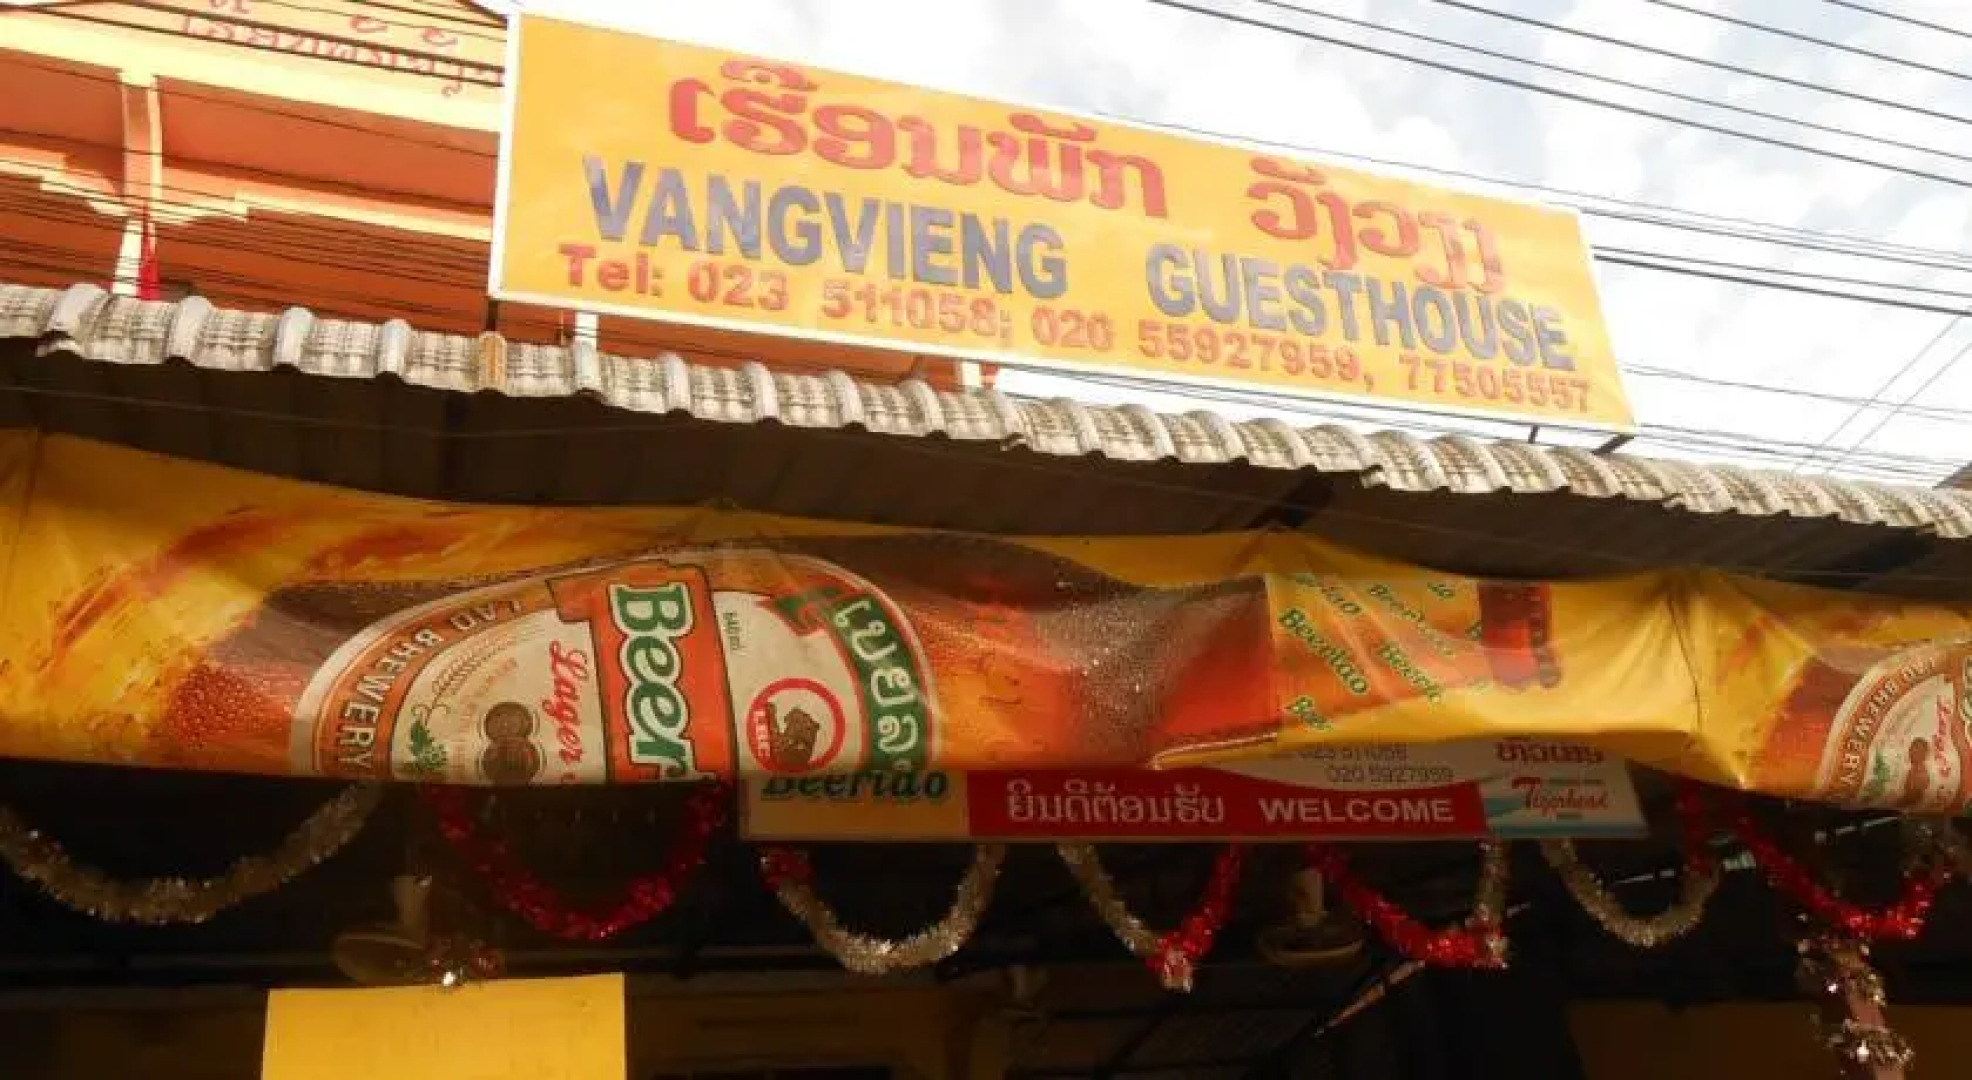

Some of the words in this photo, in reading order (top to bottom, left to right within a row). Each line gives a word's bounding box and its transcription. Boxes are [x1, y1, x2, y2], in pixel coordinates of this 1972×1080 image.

[558, 243, 663, 297] Tel:
[687, 261, 790, 312] 023
[820, 280, 1013, 343] 511058;
[1030, 308, 1114, 352] 020
[1137, 319, 1376, 391] 55927959,
[1398, 353, 1591, 413] 77505557
[584, 155, 1067, 300] VANGVIENG
[1145, 242, 1576, 372] GUESTHOUSE
[309, 627, 444, 771] BREWERY
[542, 640, 589, 765] Lager
[1258, 798, 1456, 825] WELCOME
